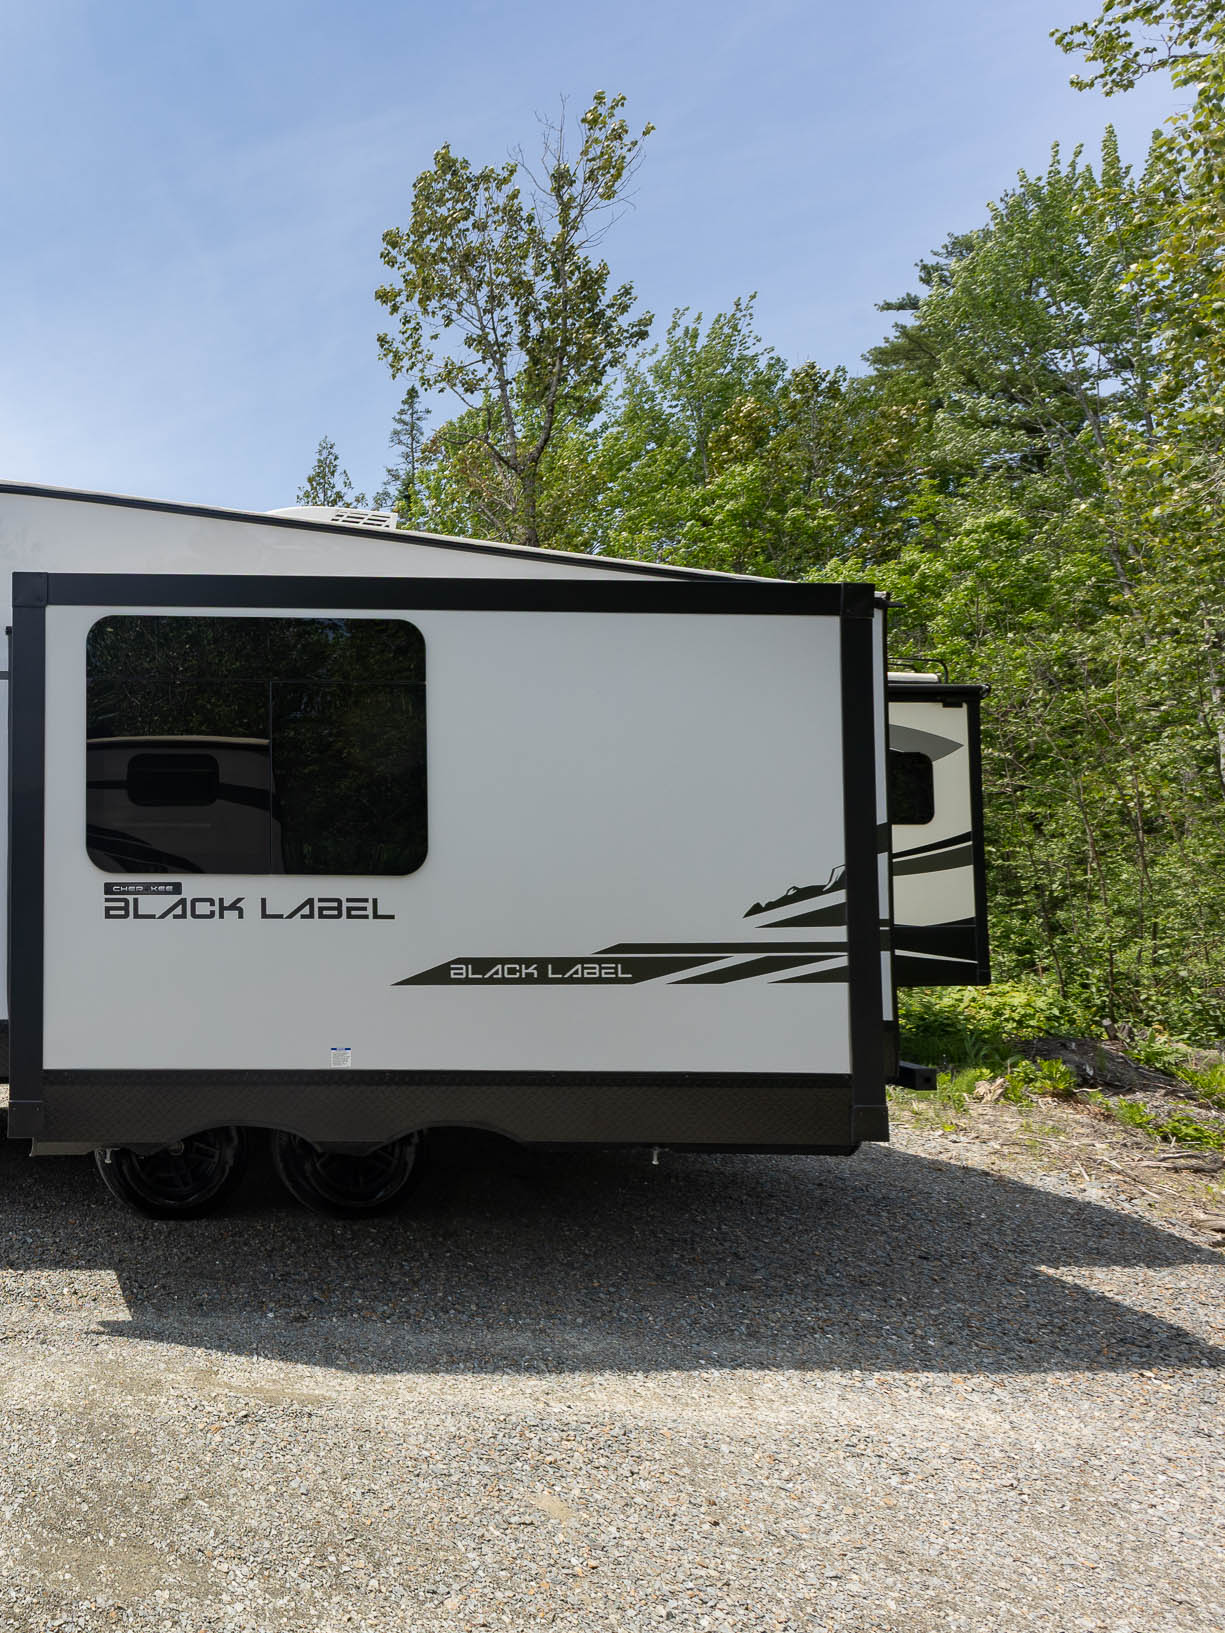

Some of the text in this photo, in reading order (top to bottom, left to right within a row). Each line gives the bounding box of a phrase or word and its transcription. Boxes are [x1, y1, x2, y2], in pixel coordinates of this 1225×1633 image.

[104, 897, 395, 920] BLACK LABEL
[450, 963, 633, 979] BLACK LABEL
